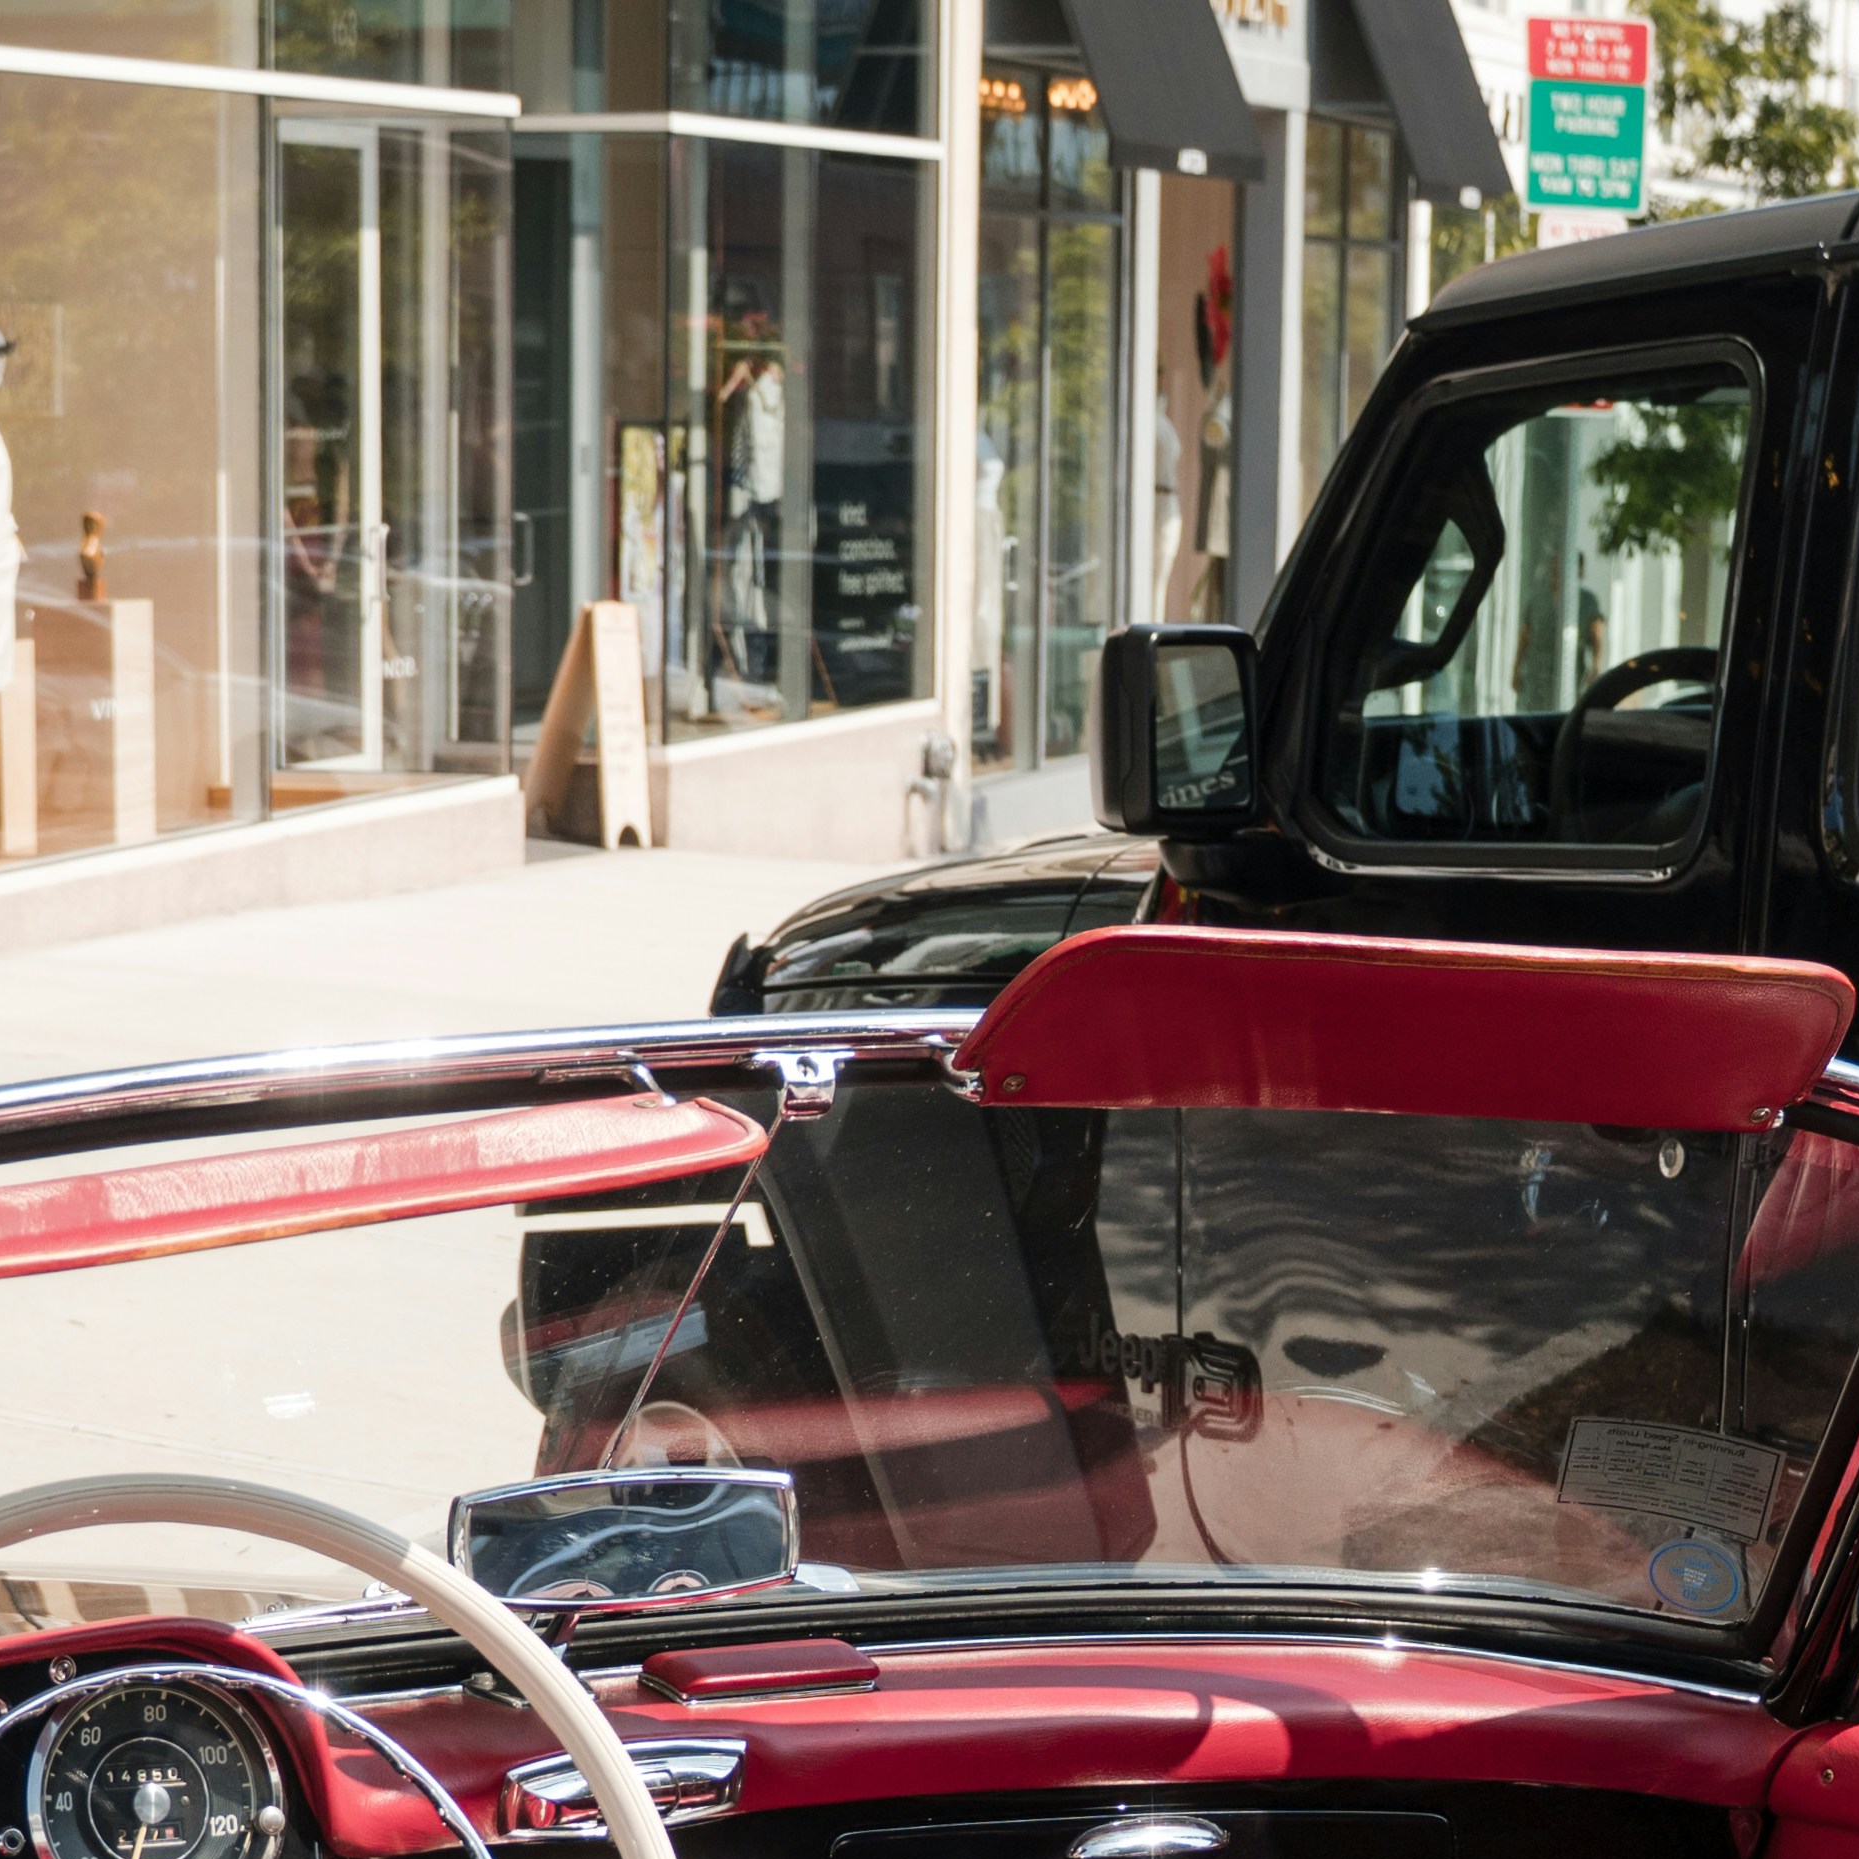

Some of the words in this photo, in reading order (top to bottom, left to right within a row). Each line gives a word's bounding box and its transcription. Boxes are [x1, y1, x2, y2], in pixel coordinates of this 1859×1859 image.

[1551, 21, 1570, 39] NO
[1573, 22, 1624, 42] PARKING
[1546, 58, 1574, 75] MON
[1577, 60, 1606, 78] THRU
[1550, 91, 1583, 114] TWO
[1585, 94, 1626, 117] HOUR
[1554, 115, 1619, 138] PARKING
[1530, 152, 1564, 173] MON
[1567, 154, 1606, 177] THRU
[1608, 157, 1639, 179] SAT
[1077, 1312, 1162, 1394] Jeep
[143, 1704, 167, 1723] 80
[80, 1726, 102, 1746] 60
[199, 1745, 228, 1765] 100
[55, 1791, 73, 1812] 40
[209, 1813, 239, 1838] 120
